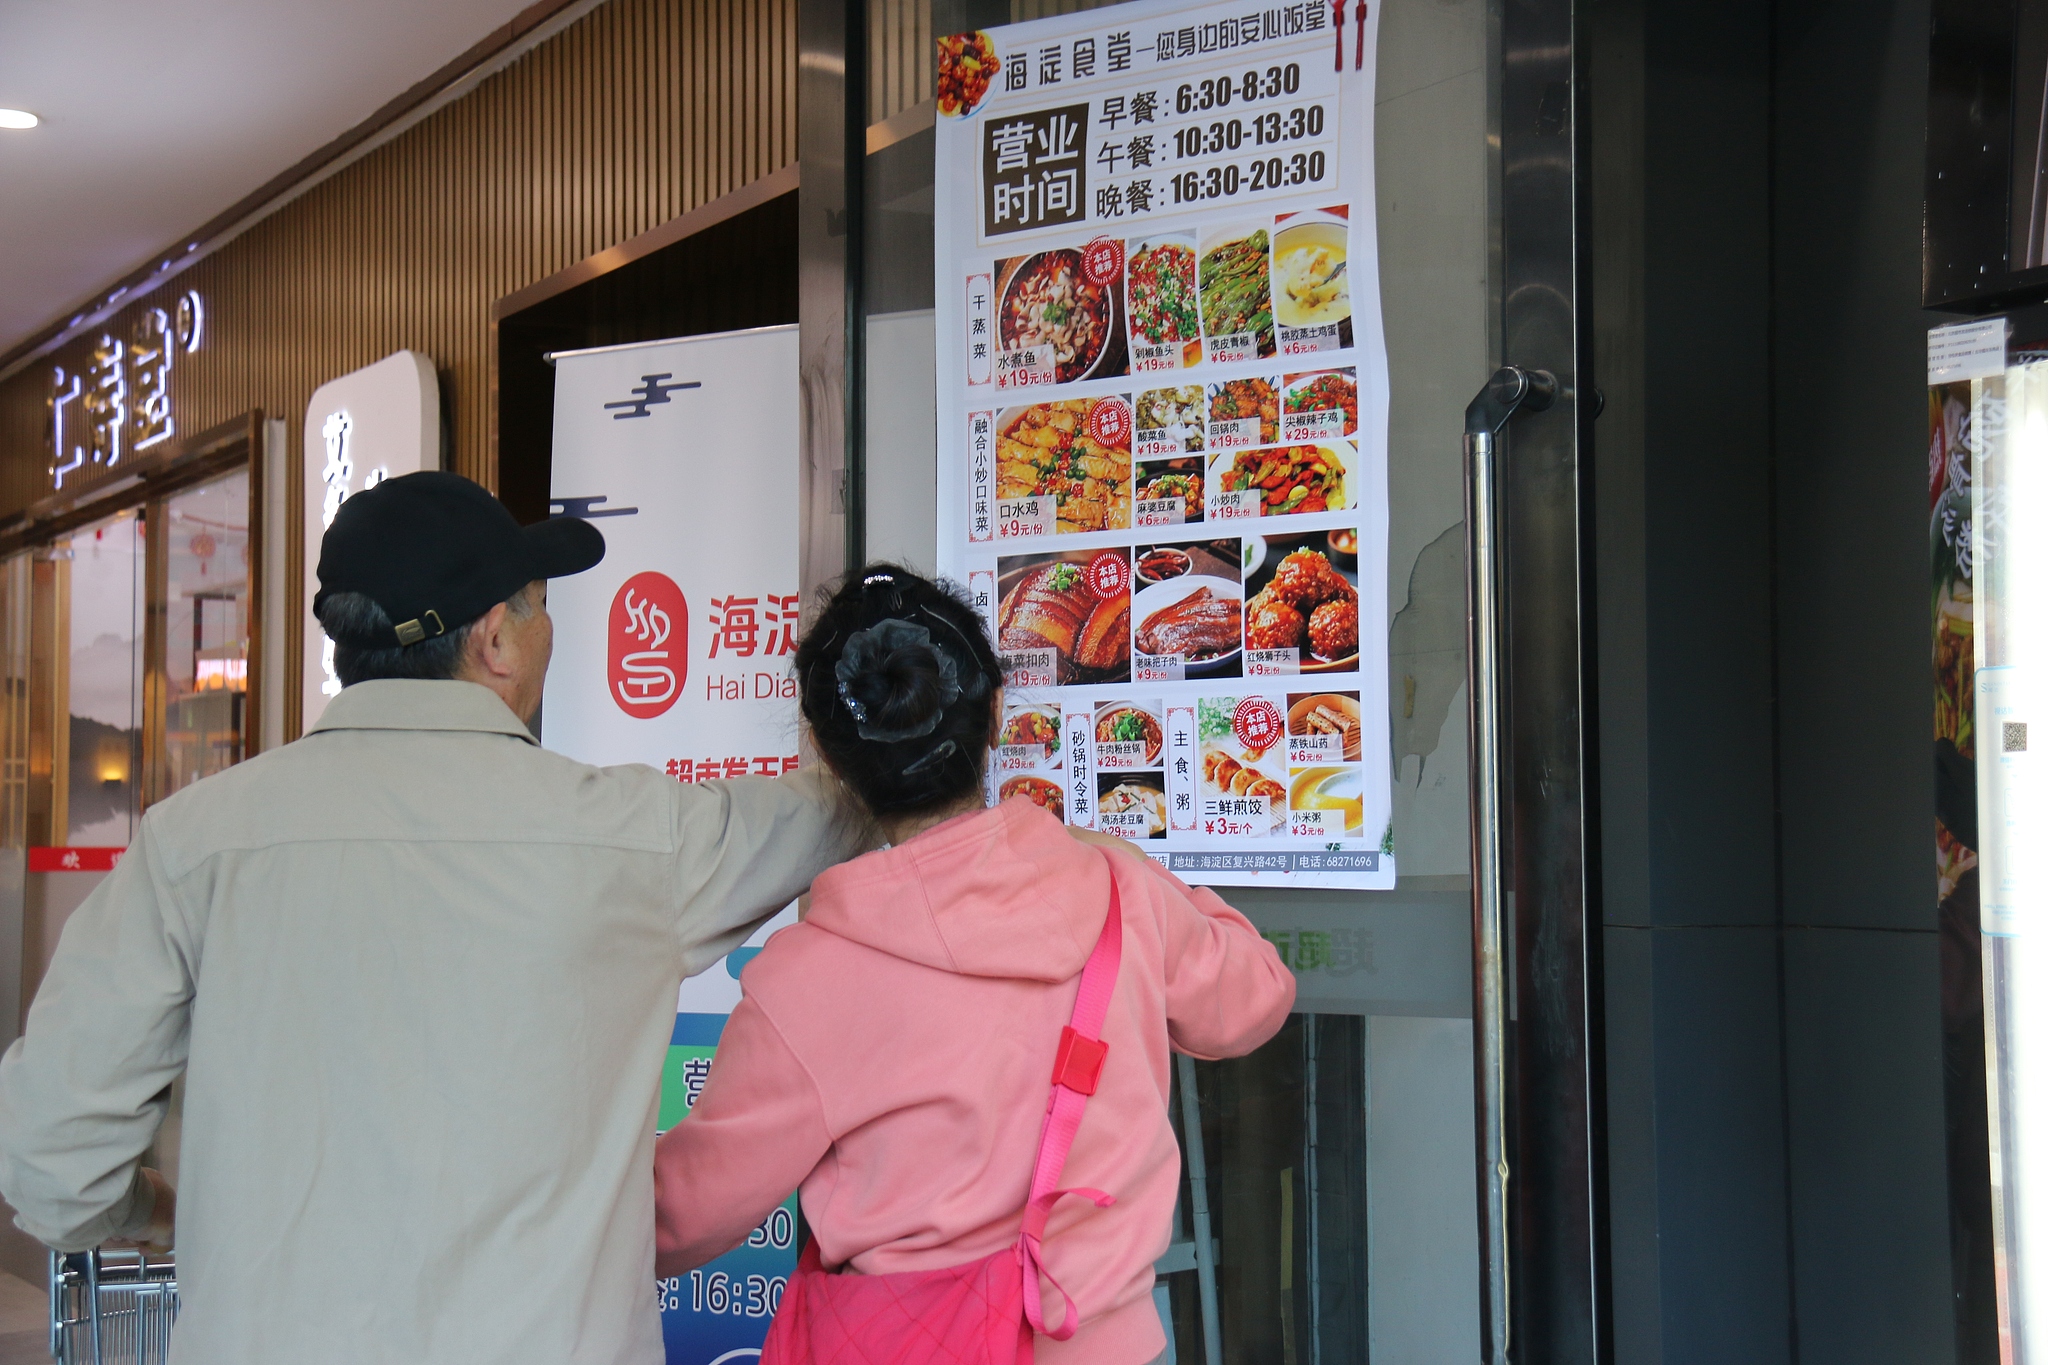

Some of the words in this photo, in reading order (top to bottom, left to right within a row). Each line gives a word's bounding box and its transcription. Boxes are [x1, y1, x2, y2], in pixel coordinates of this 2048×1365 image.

[993, 115, 1079, 173] 营业
[994, 167, 1077, 224] 时间
[1094, 249, 1111, 264] 本店
[1095, 260, 1113, 275] 推荐
[973, 294, 987, 360] 干蒸菜
[1210, 335, 1250, 351] 虎皮青椒
[1135, 345, 1174, 359] 剁椒鱼头
[998, 350, 1037, 371] 水煮鱼
[998, 369, 1053, 388] ¥19元/份
[1100, 410, 1117, 425] 本店
[1285, 414, 1338, 428] 尖椒辣子鸡
[1101, 421, 1119, 436] 推荐
[1210, 422, 1239, 436] 回锅肉
[1137, 430, 1167, 443] 酸菜鱼
[974, 418, 988, 532] 融合小炒口味菜
[1211, 493, 1240, 506] 小炒肉
[1000, 501, 1039, 519] 口水鸡
[1137, 502, 1176, 514] 麻婆豆腐
[1000, 519, 1043, 537] ¥9元/份
[1099, 563, 1117, 578] 本店
[1100, 574, 1119, 589] 推荐
[1136, 656, 1178, 669] 老味把子肉
[1247, 652, 1291, 663] 红烧狮子头
[706, 673, 746, 701] Hai
[1246, 710, 1266, 725] 本店
[1248, 722, 1269, 737] 推荐
[1097, 743, 1141, 755] 牛肉粉丝锅
[1289, 737, 1328, 750] 蒸铁山药
[1002, 746, 1027, 757] 红烧肉
[666, 754, 798, 784] 超市发玉
[1071, 730, 1089, 814] 砂锅时令菜
[1204, 799, 1262, 816] 三鲜煎饺
[1101, 814, 1144, 825] 鸡汤老豆腐
[1292, 812, 1322, 823] 小米粥
[1205, 817, 1253, 835] ¥3元/个
[1299, 855, 1372, 869] 电话:68271696
